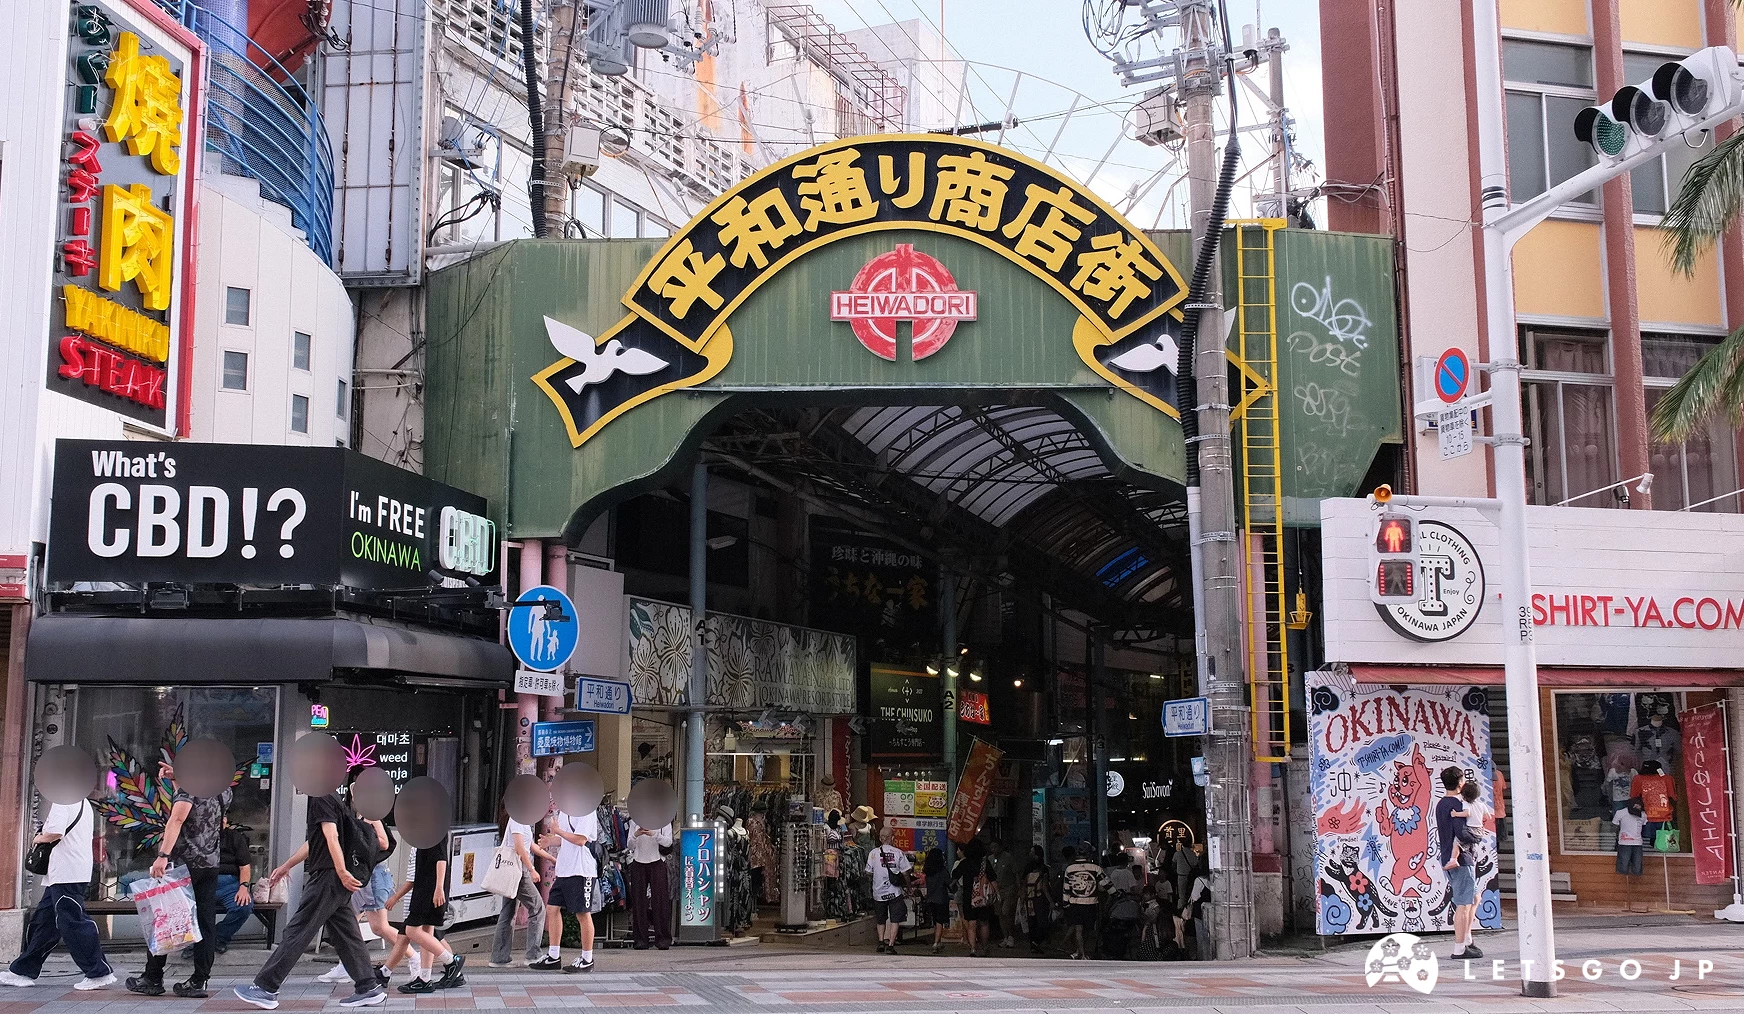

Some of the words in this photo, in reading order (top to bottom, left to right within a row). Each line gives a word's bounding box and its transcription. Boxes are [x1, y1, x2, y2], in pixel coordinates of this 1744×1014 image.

[99, 31, 183, 313] 焼肉
[647, 147, 1163, 320] 平和通り商店街
[836, 295, 970, 316] HEIWADORI
[63, 284, 169, 362] YAKINIKU
[59, 336, 165, 410] STEAK
[92, 450, 176, 478] What's
[88, 482, 307, 559] CBD!?
[350, 490, 371, 524] I'm
[377, 495, 425, 539] FREE
[351, 531, 421, 572] OKINAWA
[439, 505, 496, 577] CBD
[1429, 531, 1471, 565] CLOTHING
[1443, 588, 1460, 596] Enjoy
[1397, 606, 1439, 632] OKINAWA
[1442, 607, 1468, 631] JAPAN
[586, 683, 622, 702] 平和通り
[311, 704, 327, 719] PEN
[593, 699, 615, 709] Heiwadori
[880, 706, 894, 722] THE
[896, 707, 933, 723] CHINSUKO
[1171, 704, 1200, 722] 平和通り
[1325, 696, 1480, 757] OKINAWA
[376, 732, 410, 746] 대마초
[379, 751, 408, 763] weed
[916, 783, 947, 791] 全国配送
[893, 839, 909, 848] REE
[894, 829, 906, 837] AX
[922, 836, 938, 847] 5%
[697, 832, 711, 922] アロハシャツ
[1382, 895, 1399, 909] HAVE
